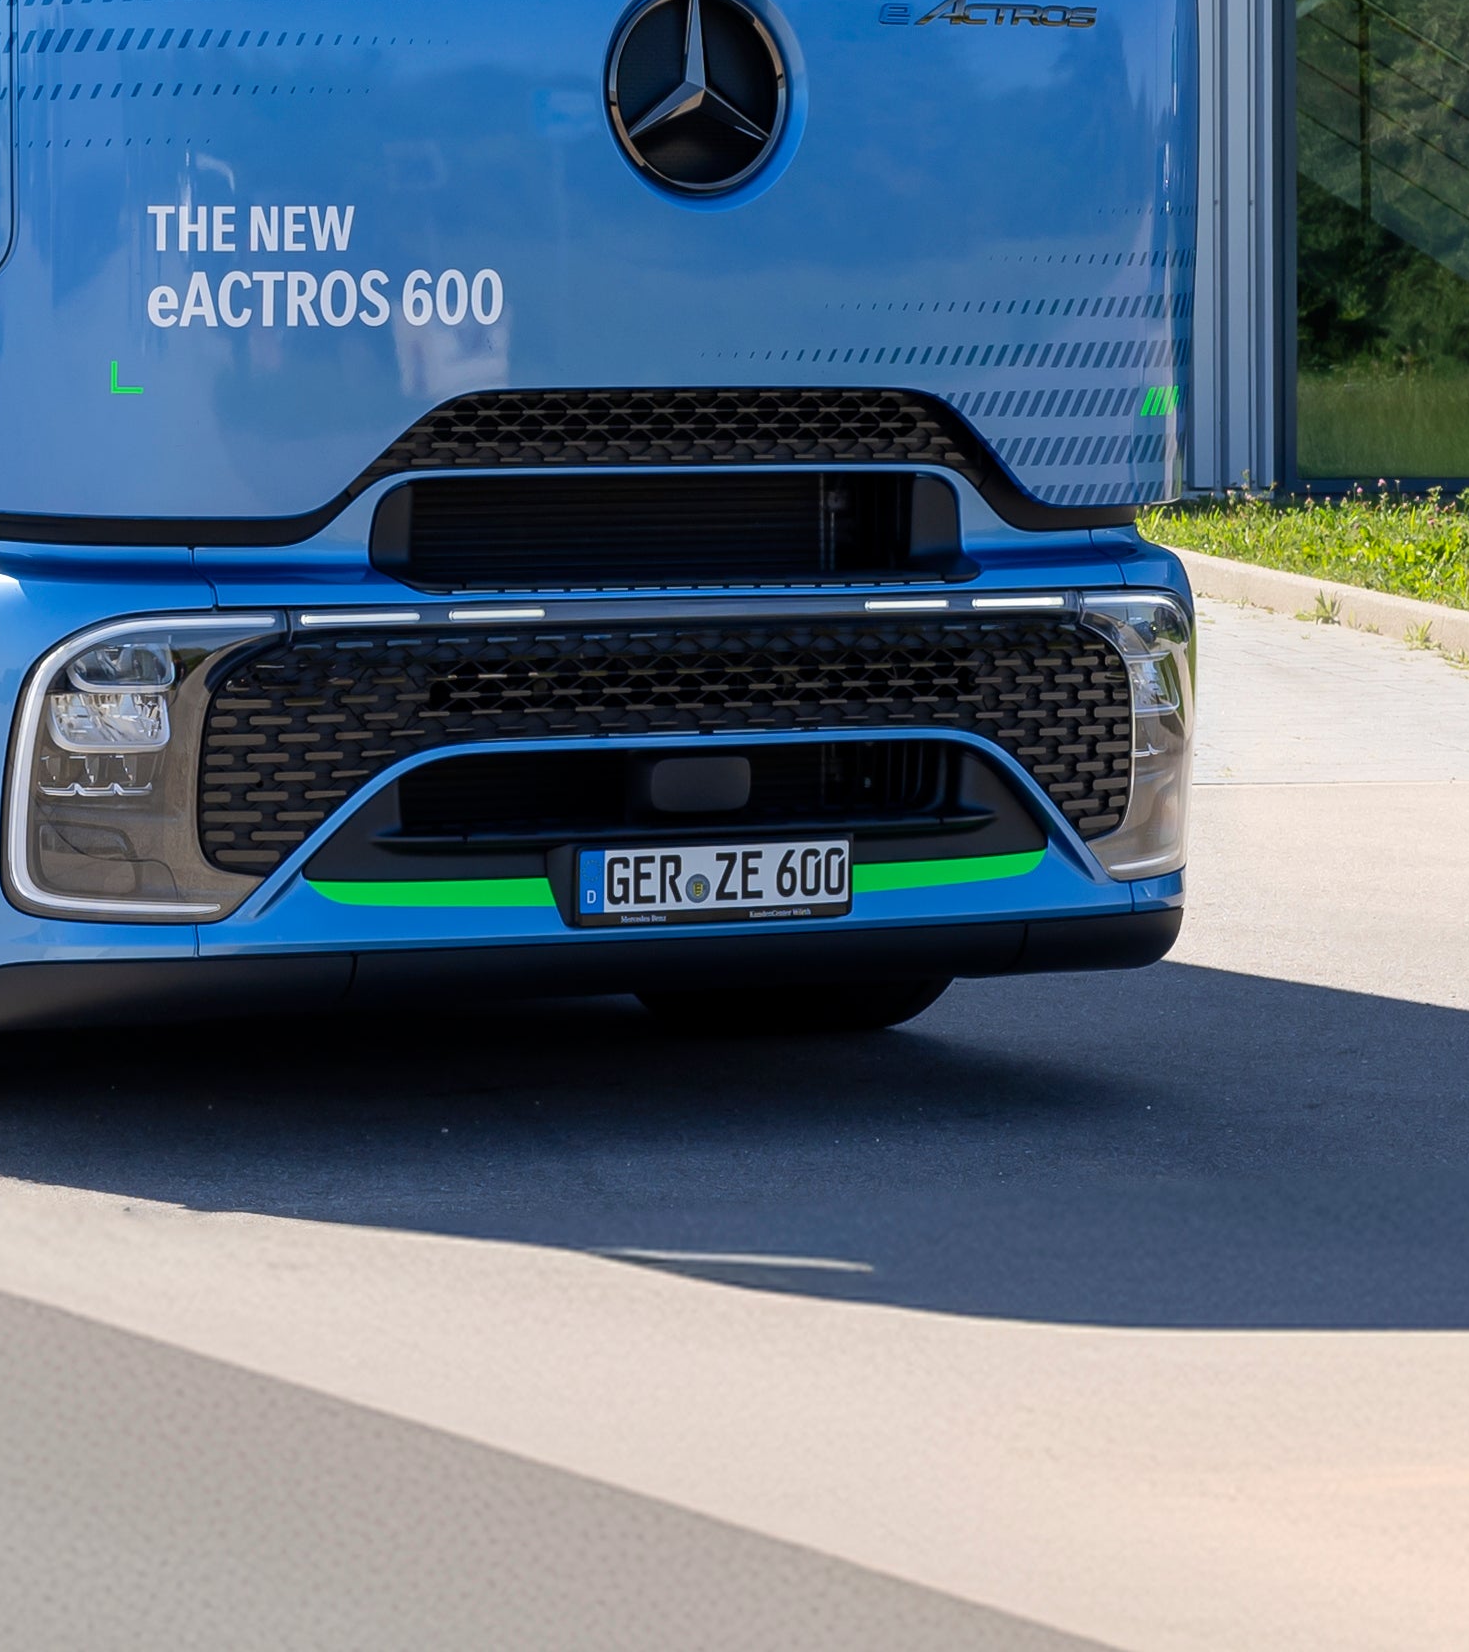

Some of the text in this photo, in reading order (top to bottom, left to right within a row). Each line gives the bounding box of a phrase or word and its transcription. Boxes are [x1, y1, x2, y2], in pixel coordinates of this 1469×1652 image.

[147, 205, 355, 252] THE NEW
[147, 268, 505, 328] eACTROS 600
[586, 889, 596, 904] D
[607, 847, 846, 906] GER ZE 600
